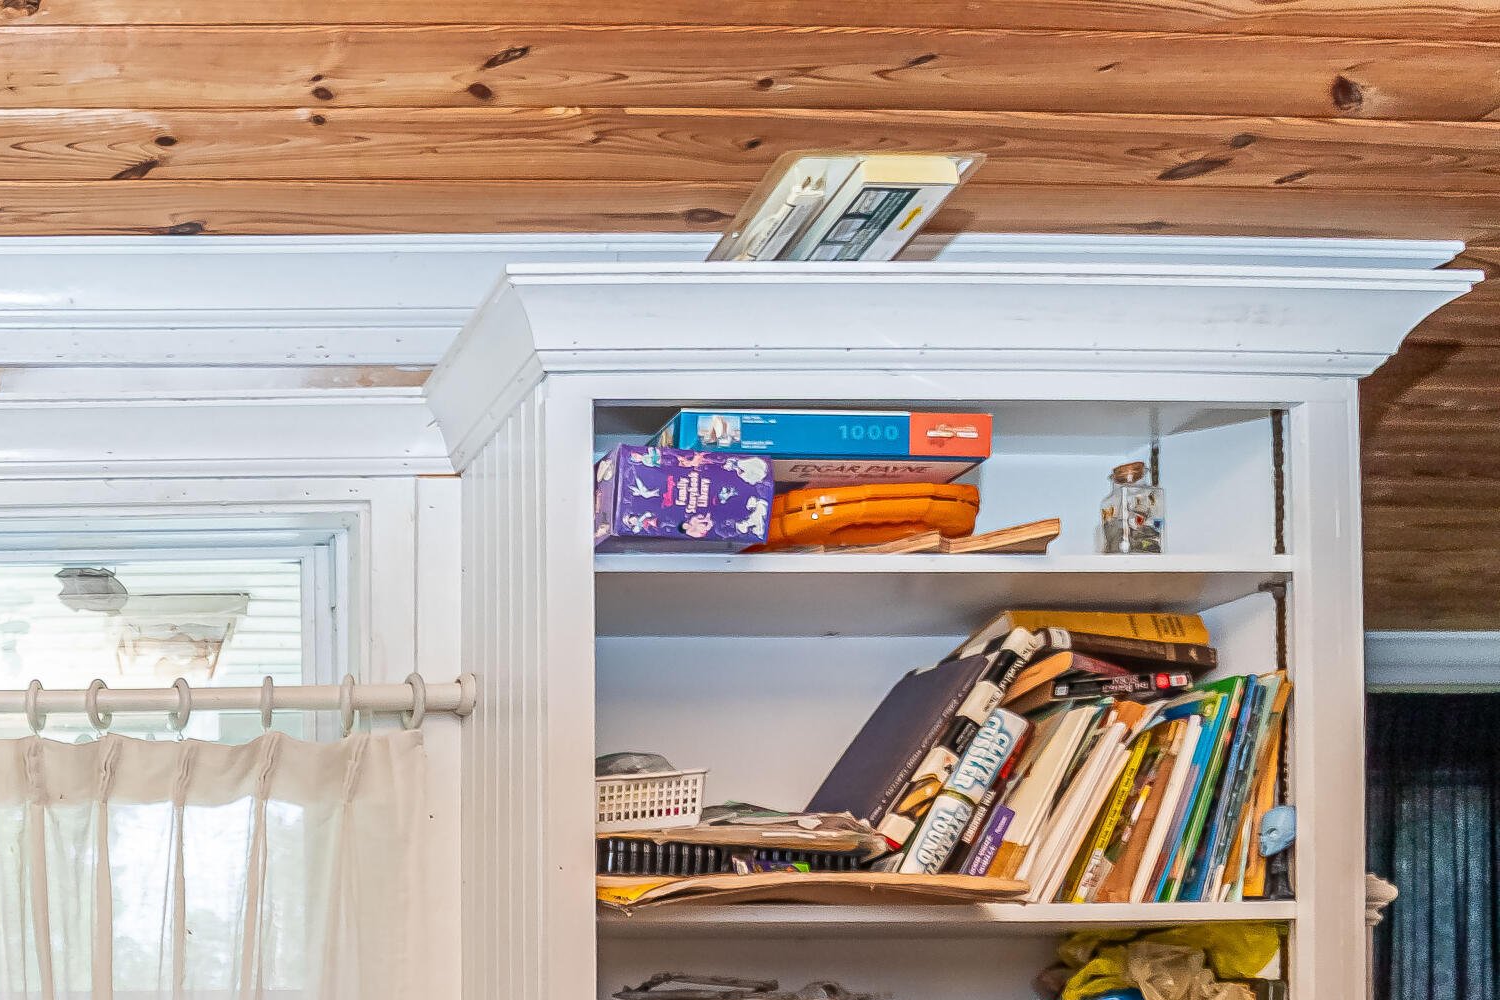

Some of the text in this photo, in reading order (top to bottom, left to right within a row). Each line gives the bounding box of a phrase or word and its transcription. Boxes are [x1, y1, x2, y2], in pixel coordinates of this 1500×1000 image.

[838, 425, 899, 440] 1000
[954, 715, 1003, 790] CUSSLER
[972, 731, 1011, 788] CLIVE
[916, 812, 952, 865] FOUND
